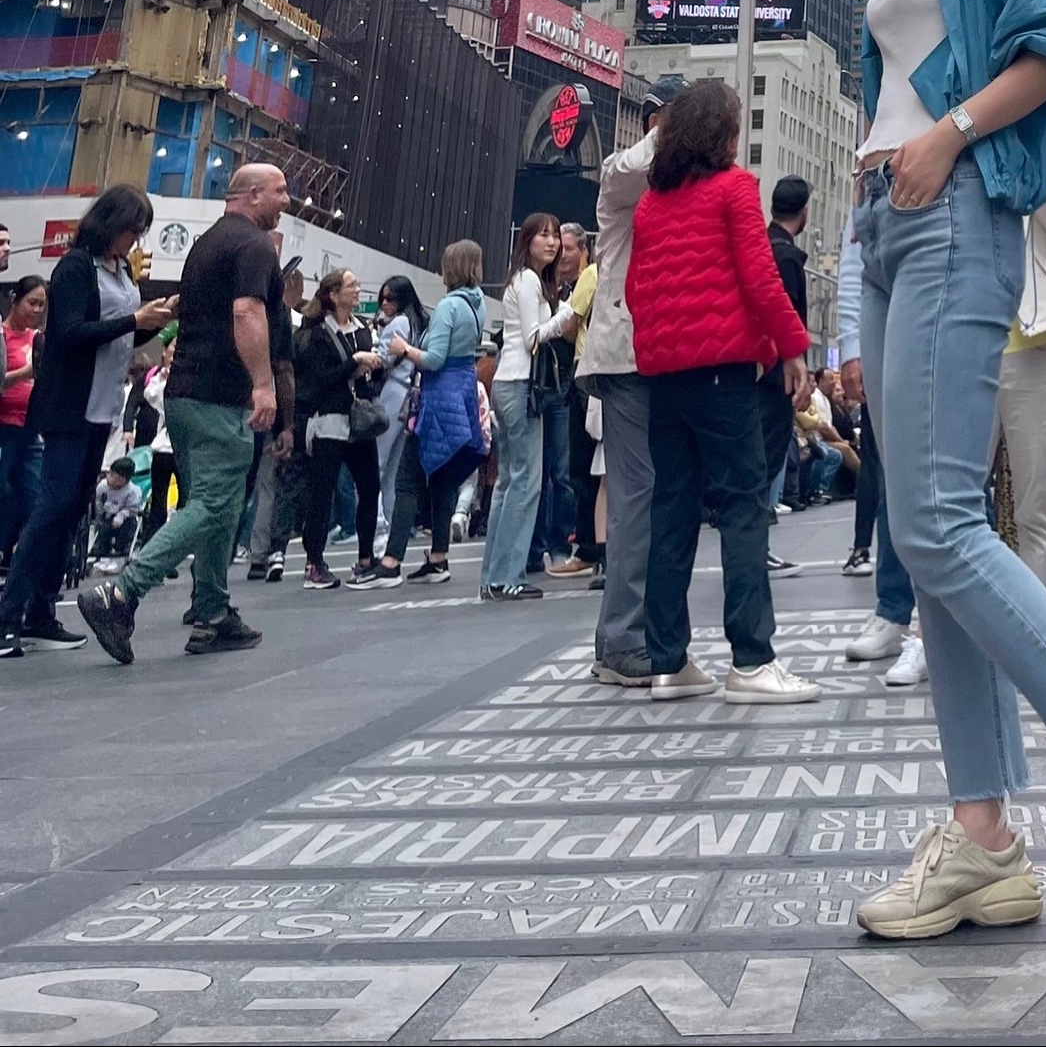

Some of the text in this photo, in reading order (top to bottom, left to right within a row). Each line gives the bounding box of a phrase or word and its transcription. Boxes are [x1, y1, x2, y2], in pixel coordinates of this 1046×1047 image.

[679, 4, 720, 18] VALDOSTA
[388, 733, 739, 758] FRIEDMAN
[455, 749, 727, 764] SAMUEL
[324, 769, 694, 792] ATKINSON
[298, 784, 682, 809] BROOKS
[230, 812, 785, 867] IMPERIAL
[135, 884, 337, 900] GOLDEN
[367, 875, 700, 897] JACOBS
[115, 898, 316, 911] JOHN
[64, 904, 688, 942] MAJESTIC
